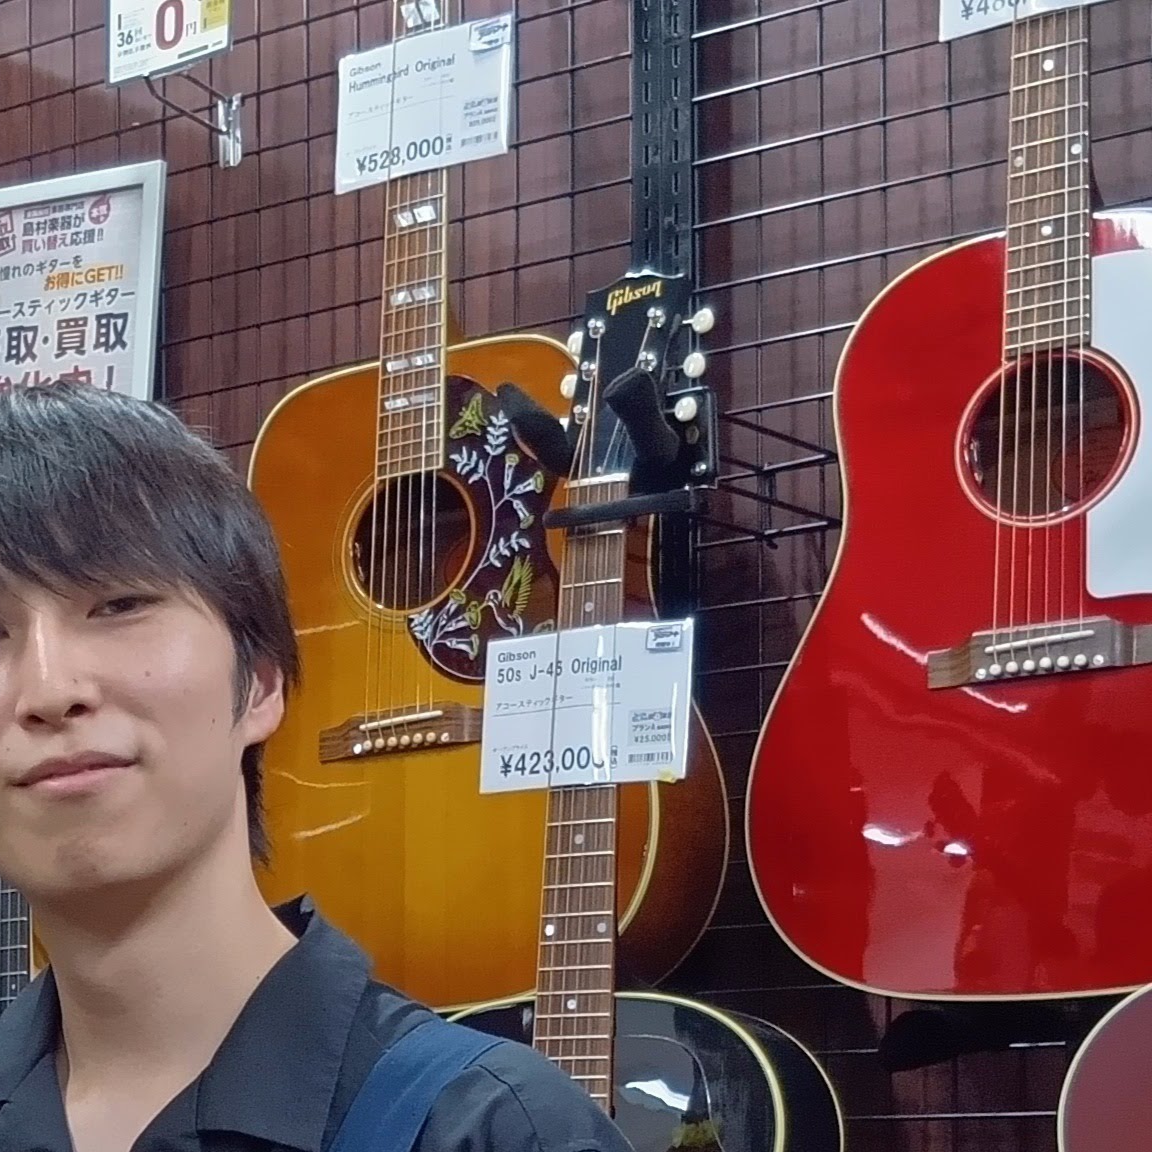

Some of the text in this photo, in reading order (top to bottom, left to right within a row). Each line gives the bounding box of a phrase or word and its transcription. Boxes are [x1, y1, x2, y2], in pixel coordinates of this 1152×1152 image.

[349, 62, 382, 78] Gibson
[415, 53, 456, 73] Original
[356, 136, 444, 176] ¥528,000
[22, 213, 85, 237] 島村楽器が
[0, 255, 83, 282] 憧れのギターを
[606, 281, 662, 316] Gibson
[497, 649, 536, 664] Gibson
[497, 666, 522, 684] 50s
[571, 655, 622, 675] Original
